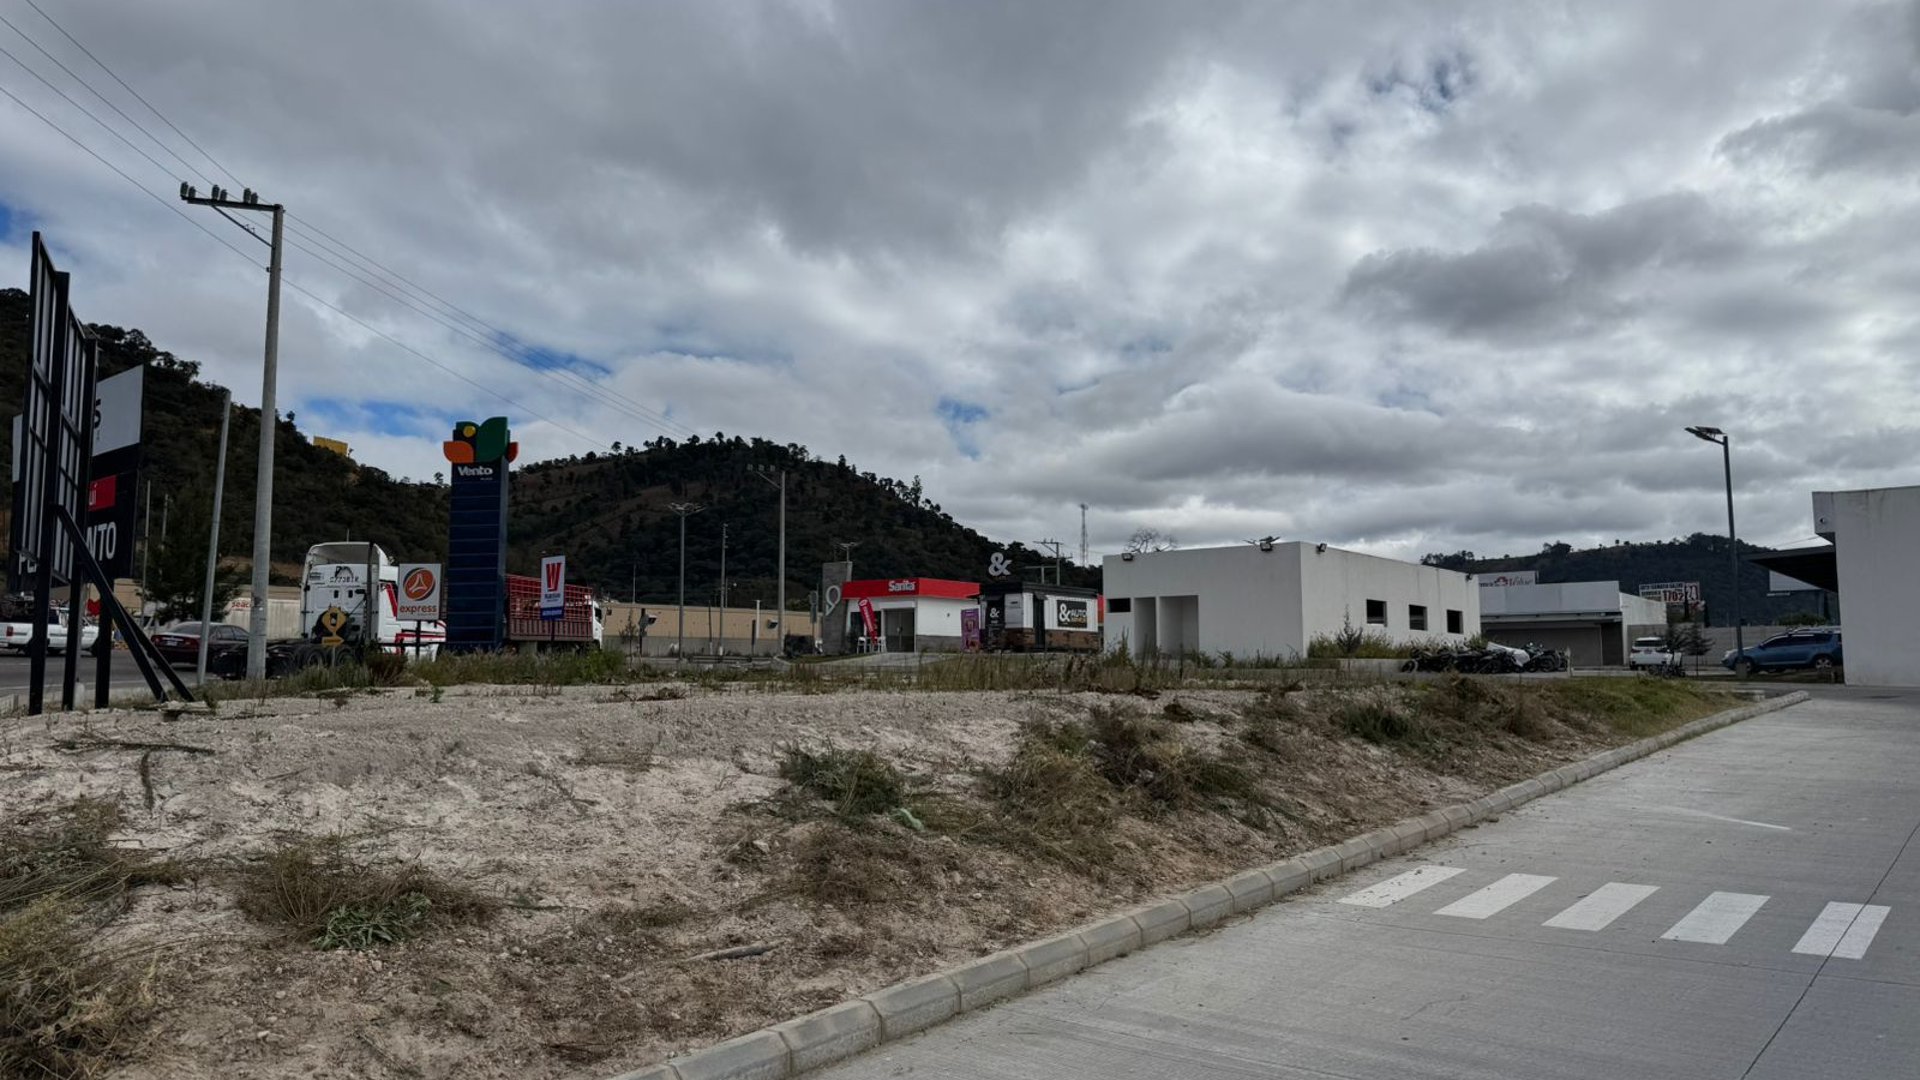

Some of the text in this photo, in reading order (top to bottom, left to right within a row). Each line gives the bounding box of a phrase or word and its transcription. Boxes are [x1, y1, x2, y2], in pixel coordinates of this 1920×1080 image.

[457, 465, 493, 476] Vento
[86, 521, 117, 562] NTO
[988, 552, 1013, 576] &
[231, 600, 251, 608] seac
[400, 605, 436, 615] express
